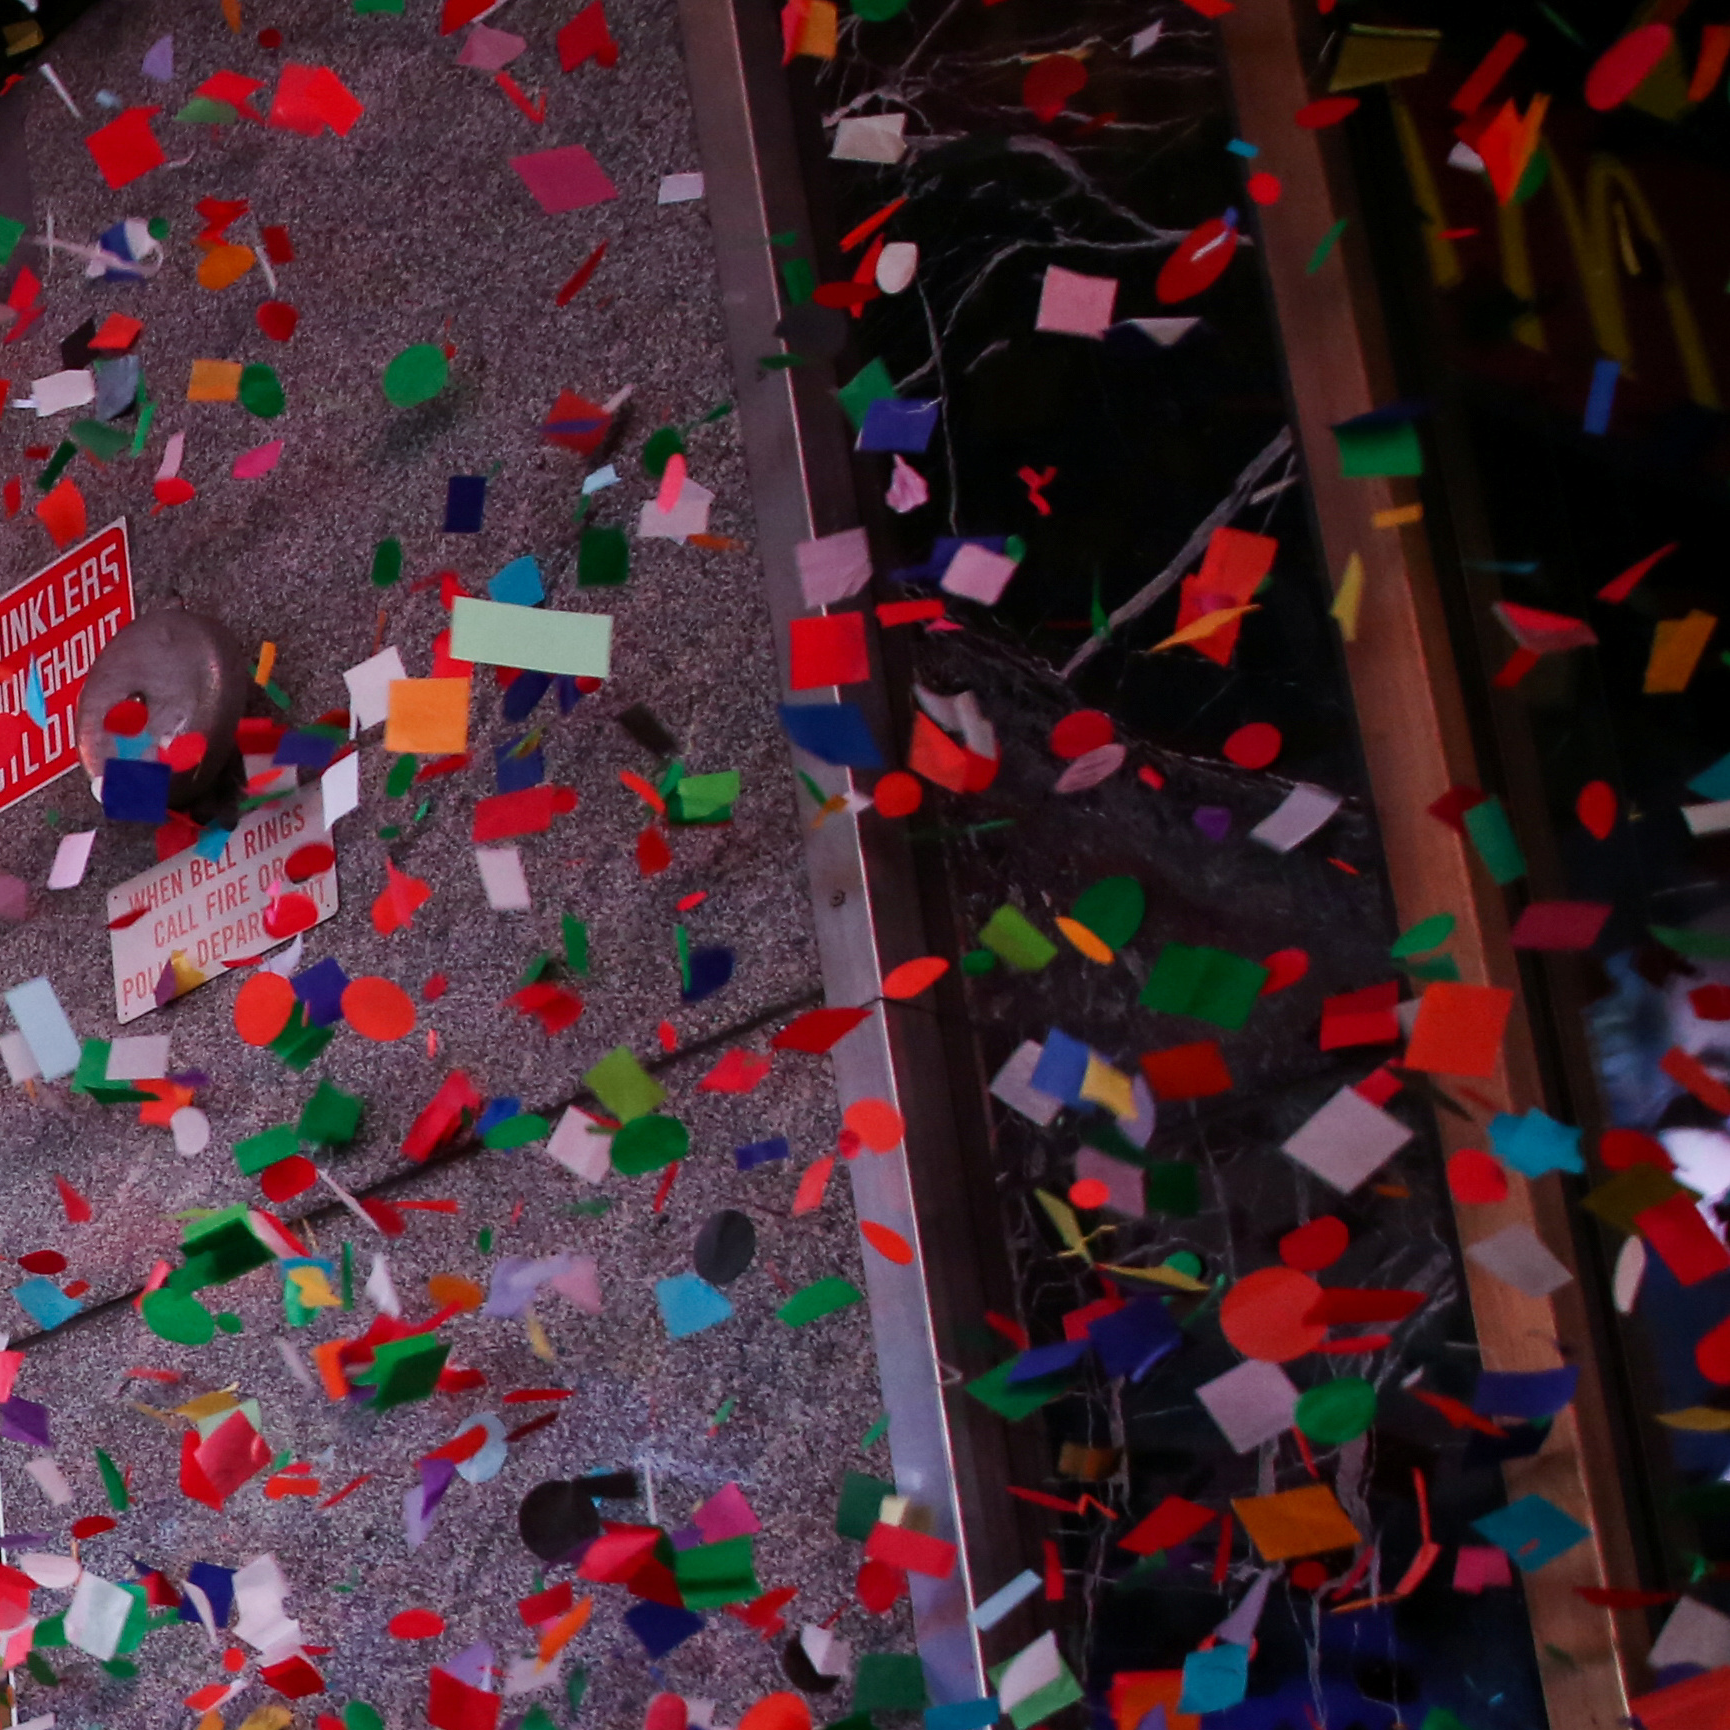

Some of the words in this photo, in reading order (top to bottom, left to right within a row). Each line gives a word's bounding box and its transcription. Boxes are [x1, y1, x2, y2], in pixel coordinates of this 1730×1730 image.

[244, 804, 306, 858] RINGS
[154, 904, 199, 948] CALL
[206, 875, 250, 920] FIRE
